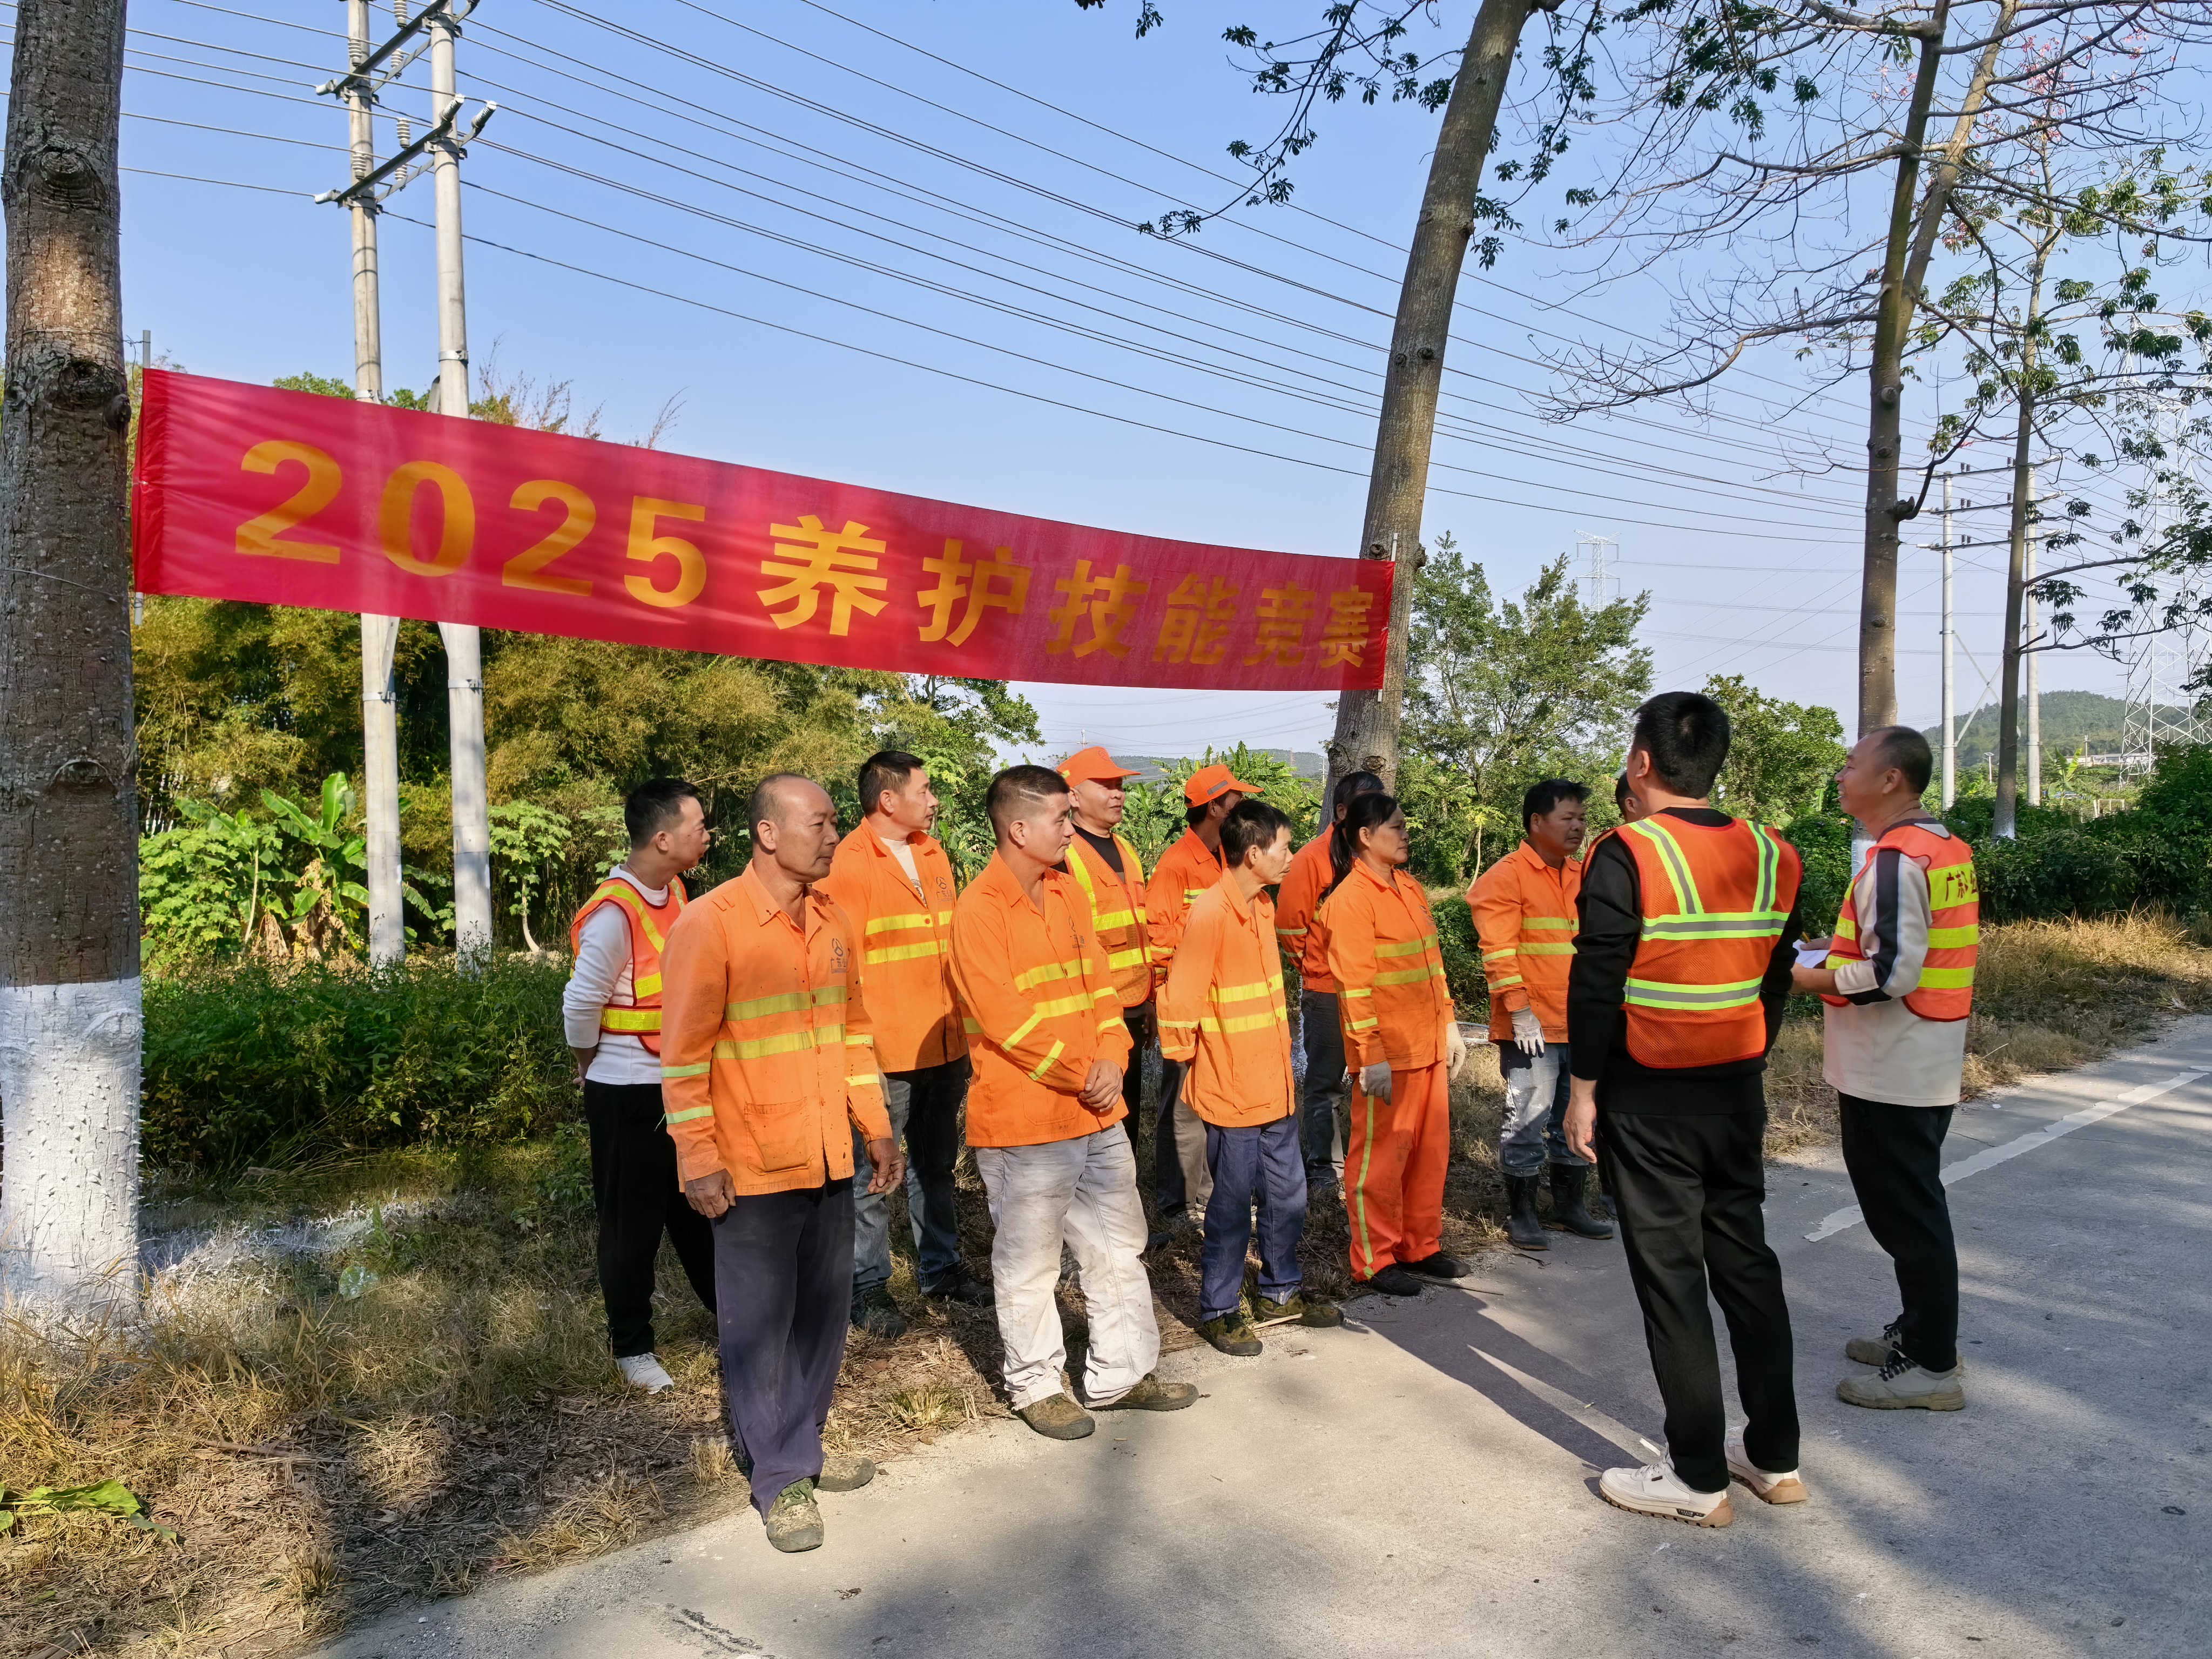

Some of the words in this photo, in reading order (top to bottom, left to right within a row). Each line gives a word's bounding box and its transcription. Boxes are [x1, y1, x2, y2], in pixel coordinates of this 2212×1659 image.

[235, 440, 1373, 667] 2025养护技能竞赛
